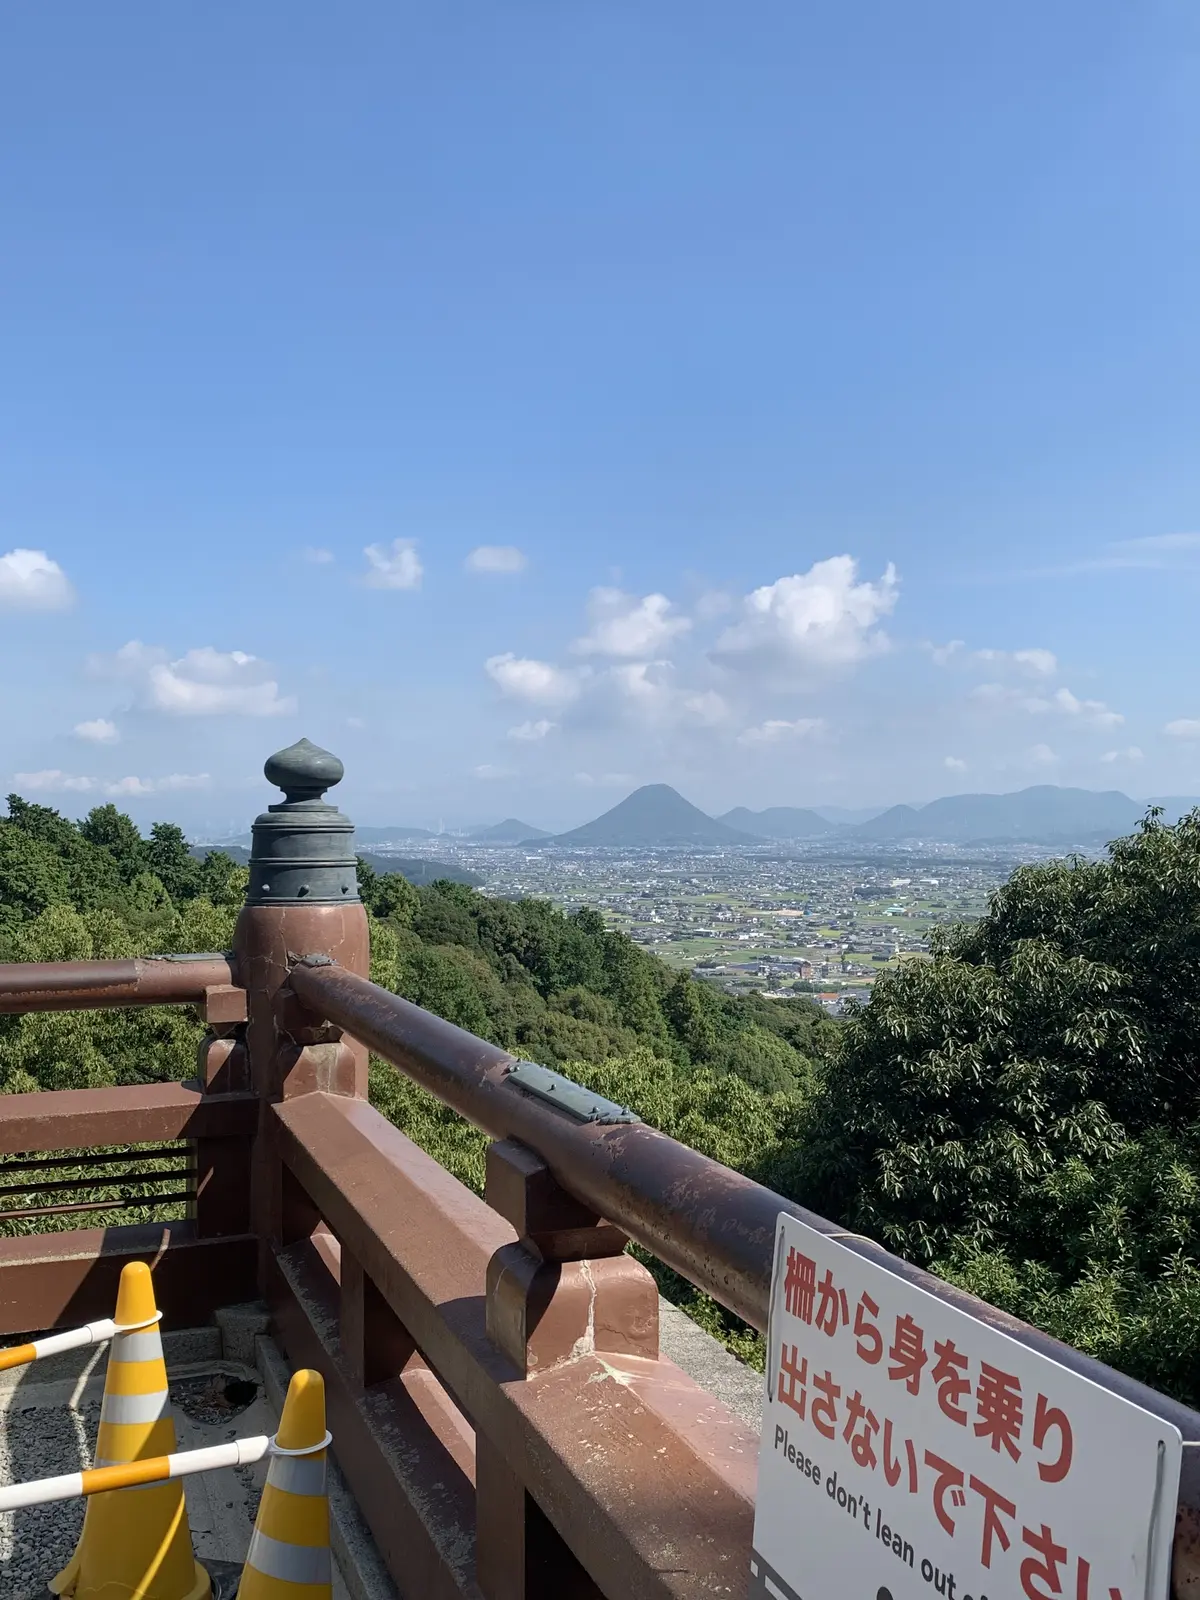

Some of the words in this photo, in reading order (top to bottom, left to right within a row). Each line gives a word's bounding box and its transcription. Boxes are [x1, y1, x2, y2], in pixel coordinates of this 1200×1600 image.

[783, 1246, 1073, 1484] 柵から身を乗り
[774, 1423, 821, 1486] Please
[826, 1470, 871, 1531] don't
[875, 1508, 915, 1568] lean
[920, 1558, 957, 1600] out
